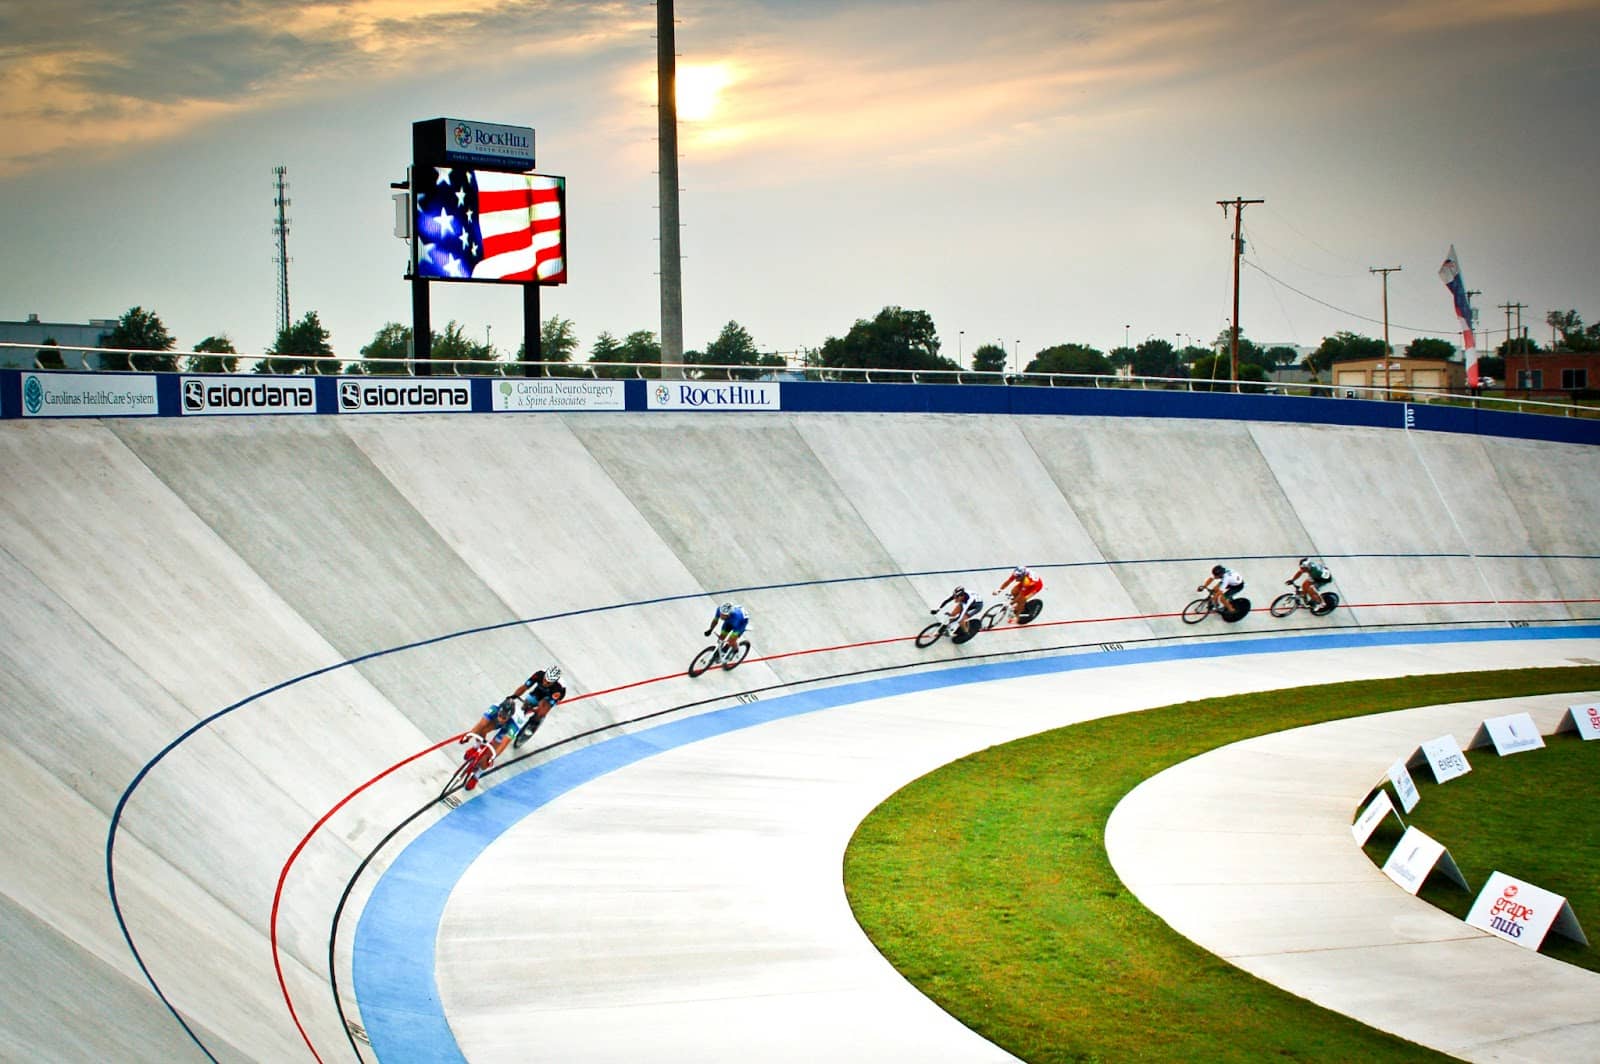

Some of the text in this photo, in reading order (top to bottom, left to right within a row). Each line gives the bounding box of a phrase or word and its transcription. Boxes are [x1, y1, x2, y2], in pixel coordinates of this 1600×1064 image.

[517, 383, 614, 397] Carolina NeuroSurgery
[44, 390, 154, 408] Carolinas HealthCare System
[526, 396, 547, 408] Spine
[549, 396, 587, 406] Associates
[1407, 408, 1415, 427] 100
[738, 693, 760, 704] 170
[1490, 897, 1534, 921] grape
